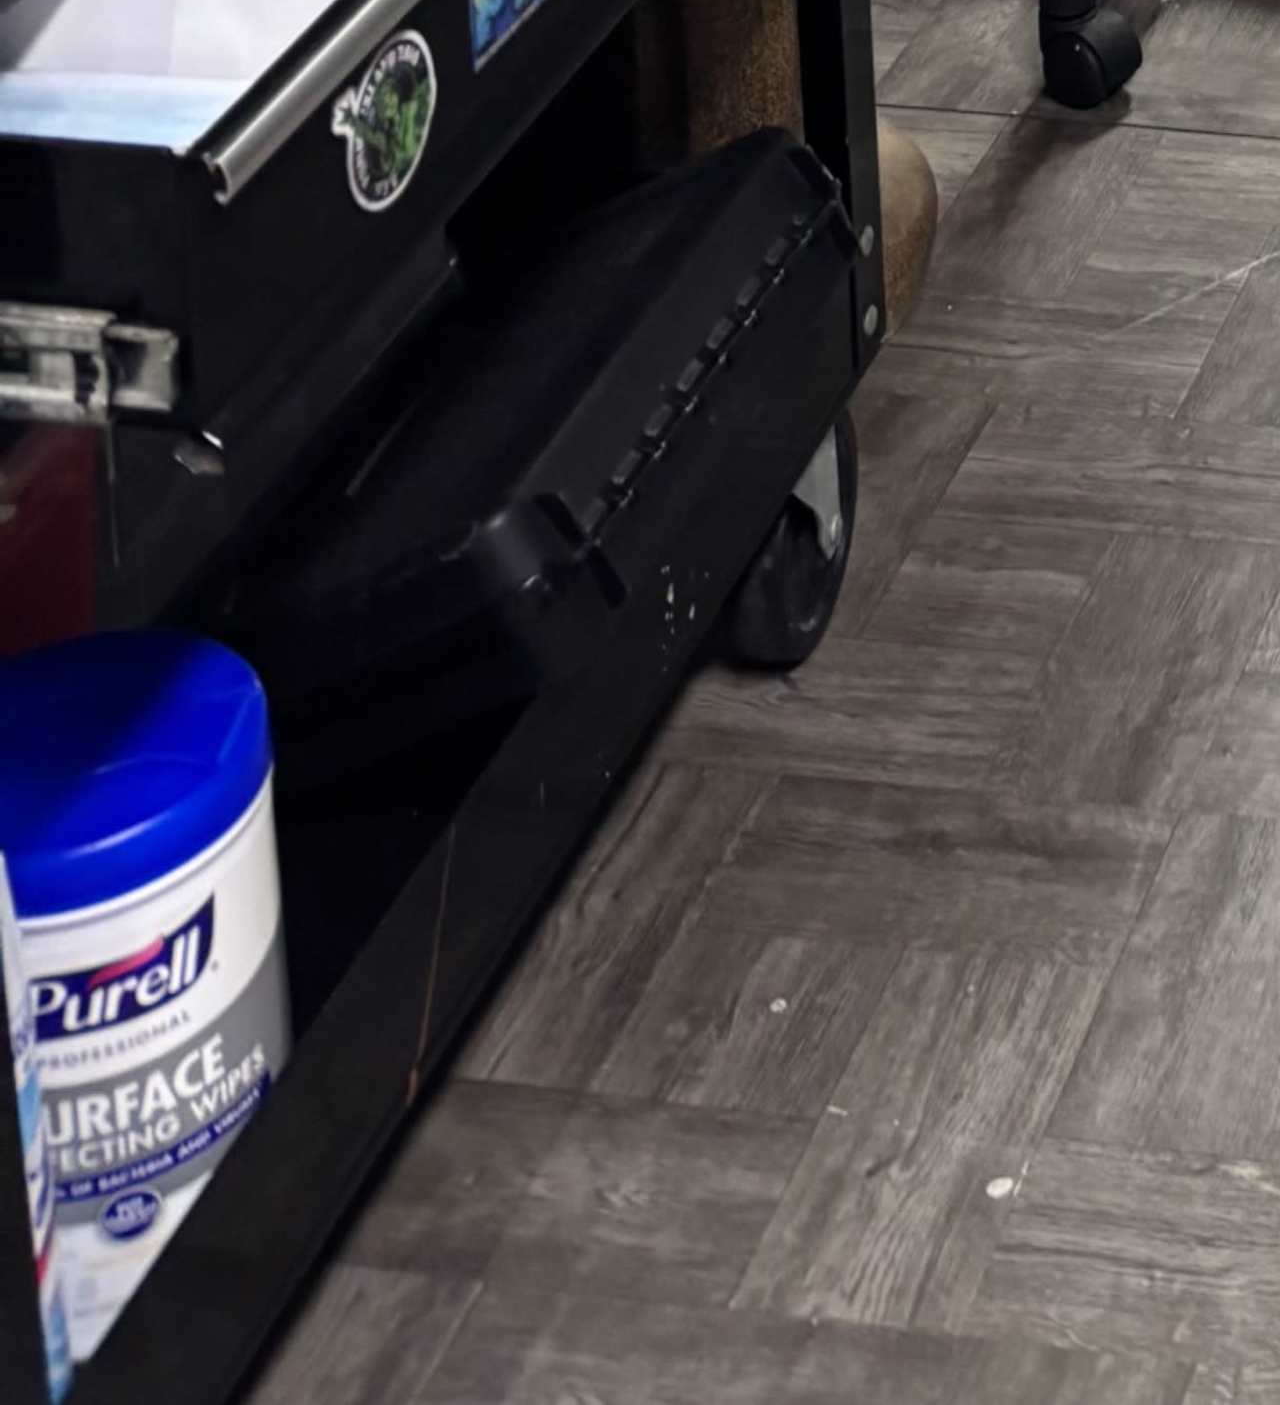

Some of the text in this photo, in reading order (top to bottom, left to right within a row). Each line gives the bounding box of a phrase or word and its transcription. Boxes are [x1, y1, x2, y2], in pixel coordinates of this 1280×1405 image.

[30, 926, 200, 1032] Purell
[37, 1009, 190, 1069] PROFESSIONAL
[46, 1033, 225, 1146] URFACE
[60, 1043, 266, 1174] ECTING WIPES
